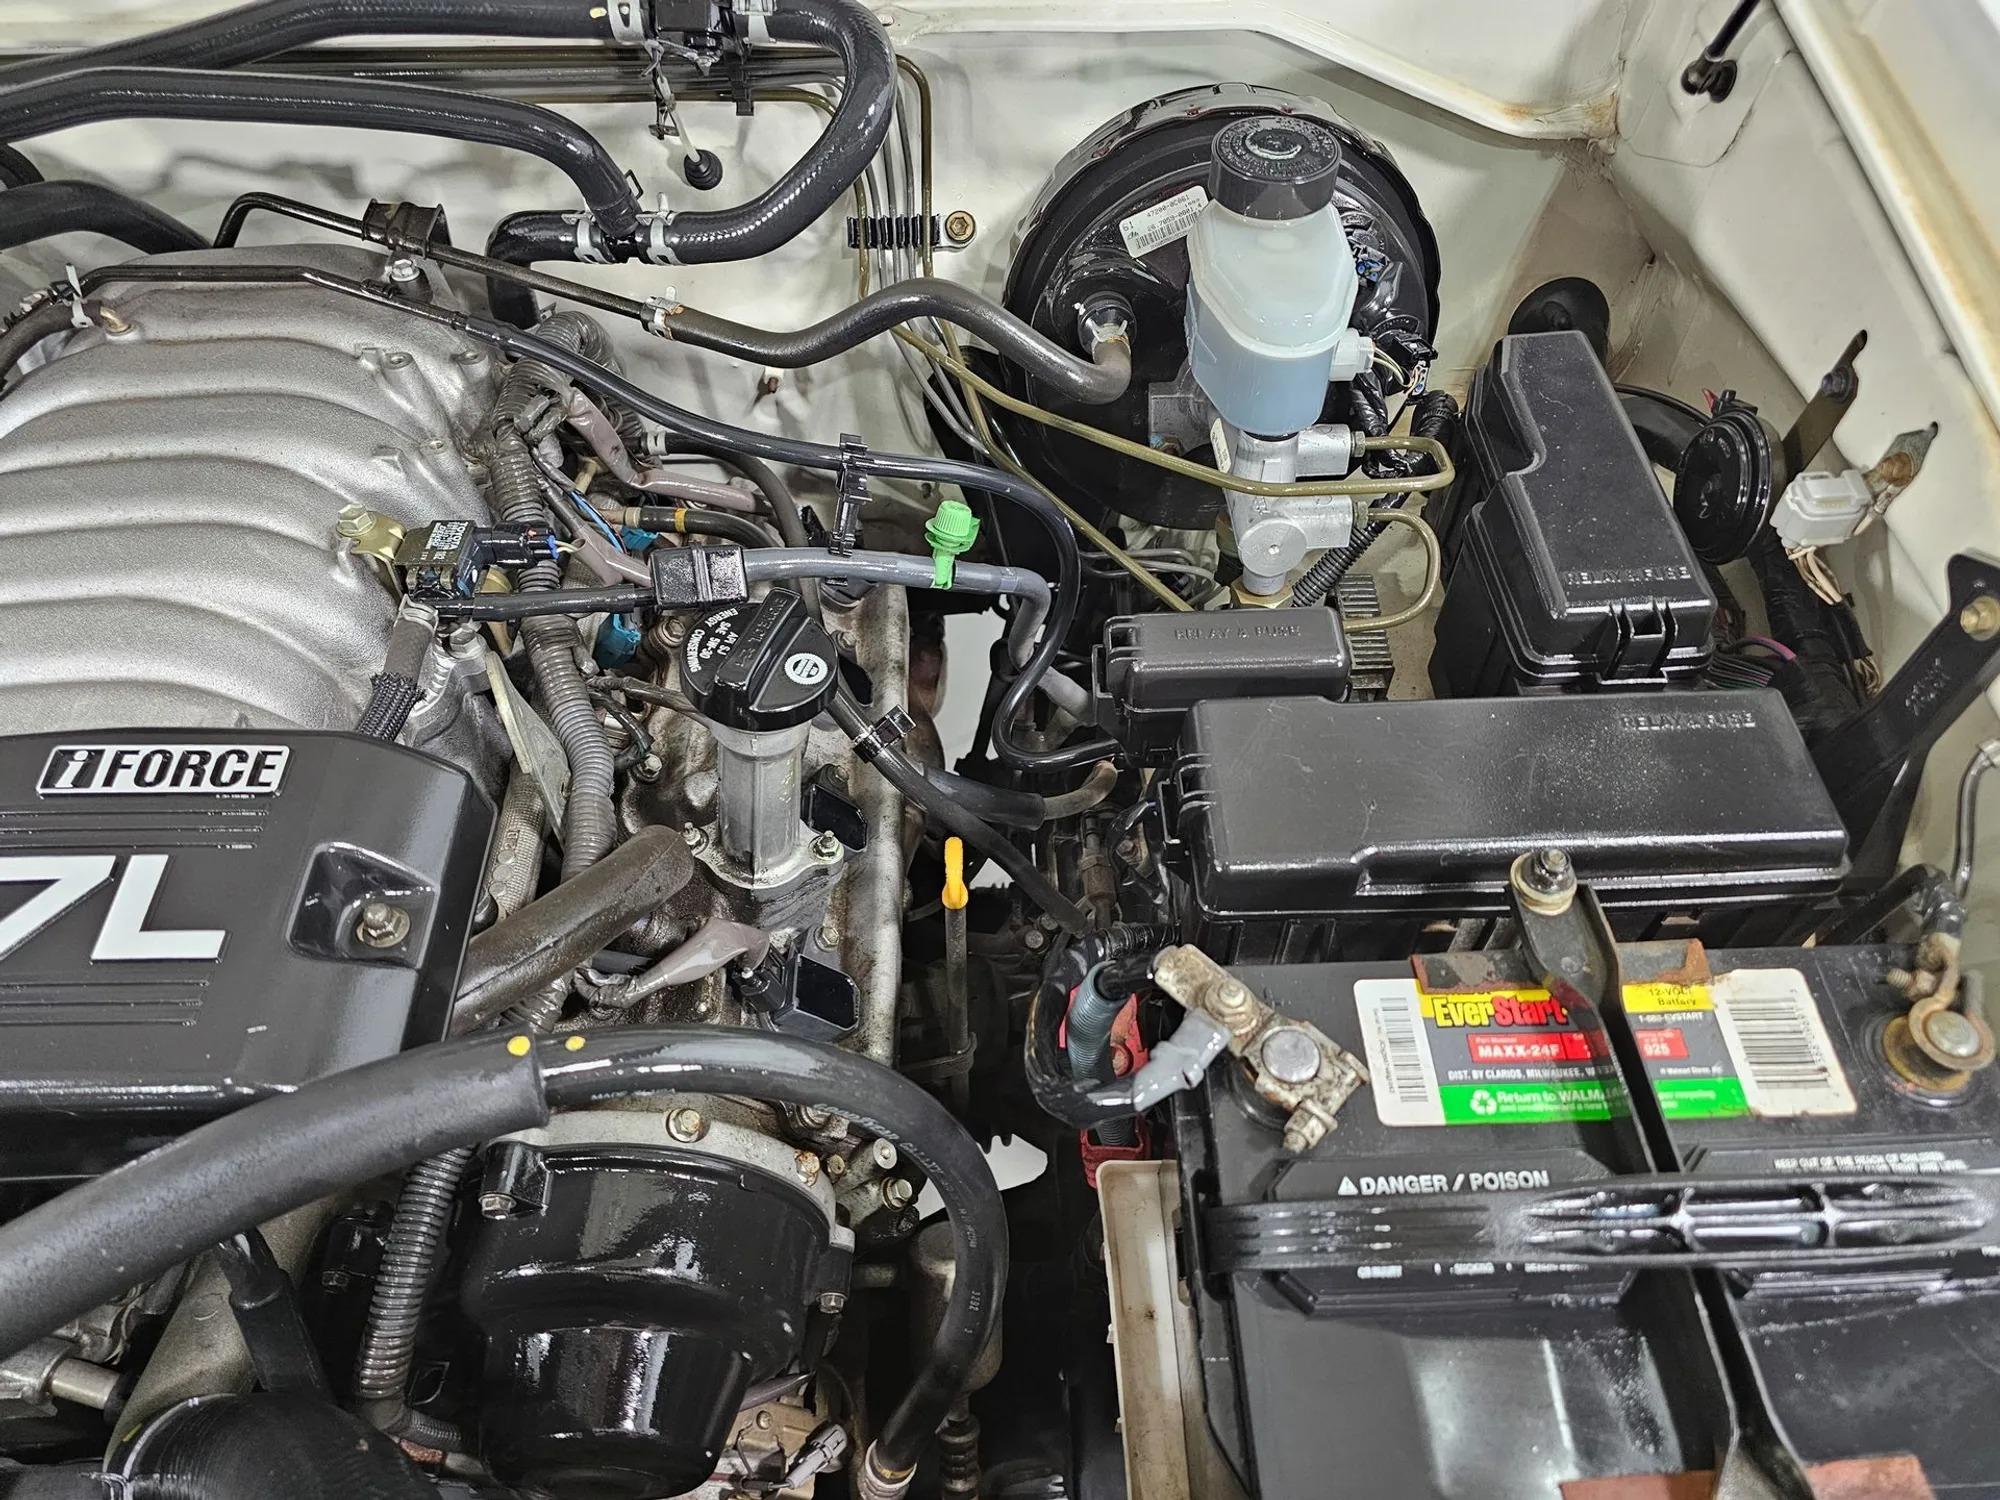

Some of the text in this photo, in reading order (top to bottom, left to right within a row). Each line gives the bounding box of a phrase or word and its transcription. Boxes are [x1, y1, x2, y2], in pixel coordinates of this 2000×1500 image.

[448, 521, 469, 550] TOYOTA
[686, 608, 739, 673] ENERGY CONSERVING
[700, 621, 731, 659] SAE 5W-30
[717, 632, 739, 656] API SJ
[1432, 994, 1568, 1028] EverStart
[1477, 1044, 1559, 1058] MAXX-24F
[1448, 1070, 1471, 1081] DIST.
[1472, 1069, 1483, 1080] BY
[1496, 1090, 1541, 1103] Return
[1542, 1090, 1557, 1101] to
[1359, 1170, 1550, 1196] DANGER / POISON
